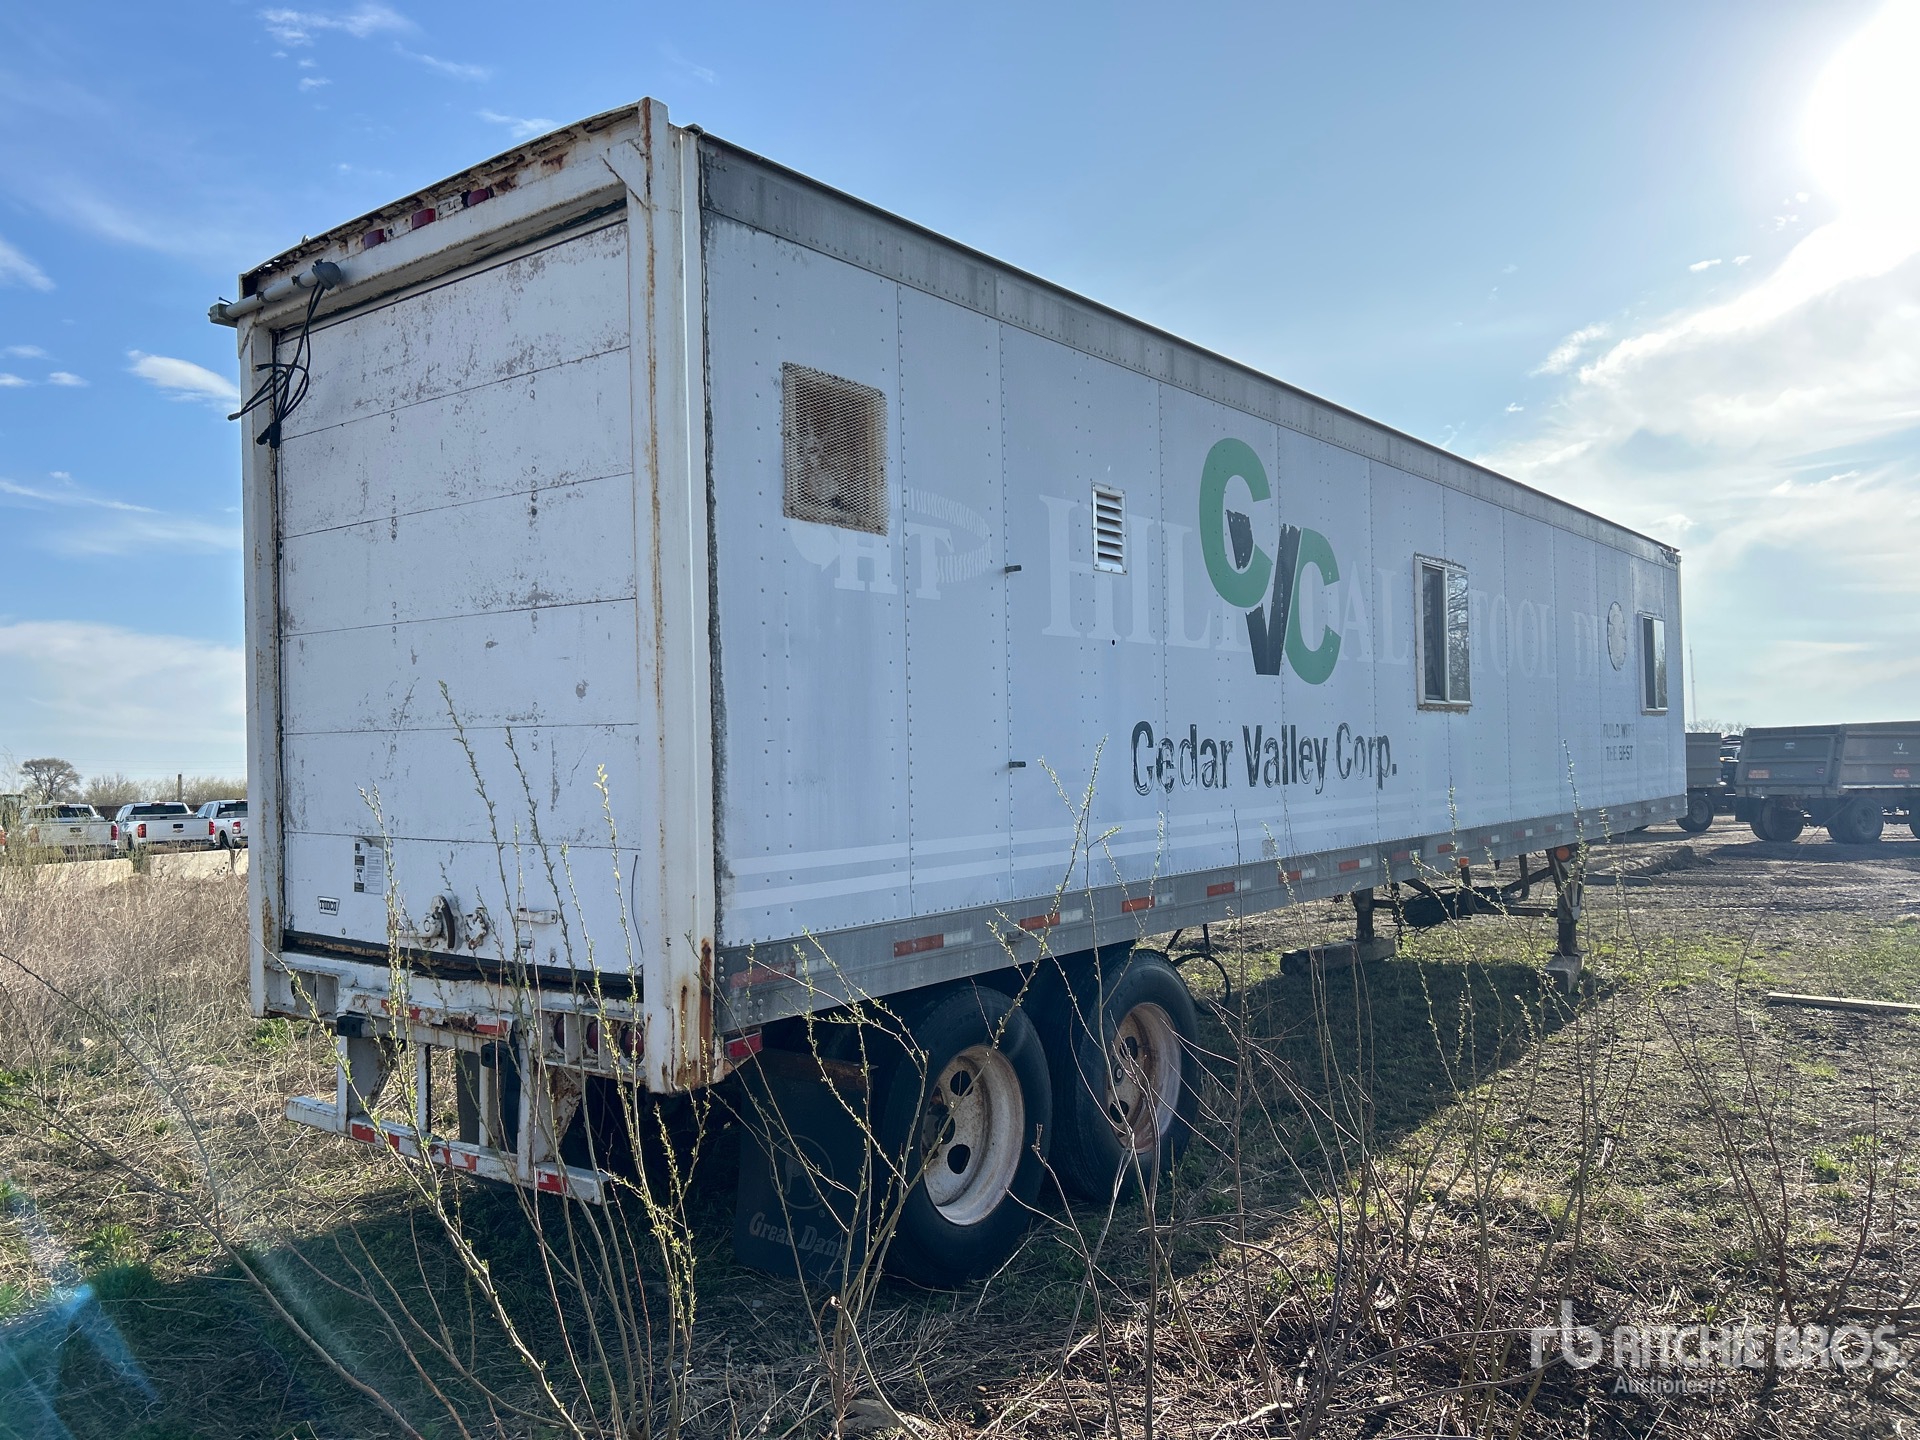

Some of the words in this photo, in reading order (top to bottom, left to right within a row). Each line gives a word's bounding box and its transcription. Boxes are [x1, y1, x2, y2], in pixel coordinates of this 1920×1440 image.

[1199, 437, 1341, 685] CVC
[1468, 588, 1556, 680] TOOL
[1131, 720, 1234, 797] Cedar
[1242, 724, 1329, 795] Valley
[1336, 722, 1398, 790] Corp.
[749, 1211, 795, 1247] Great
